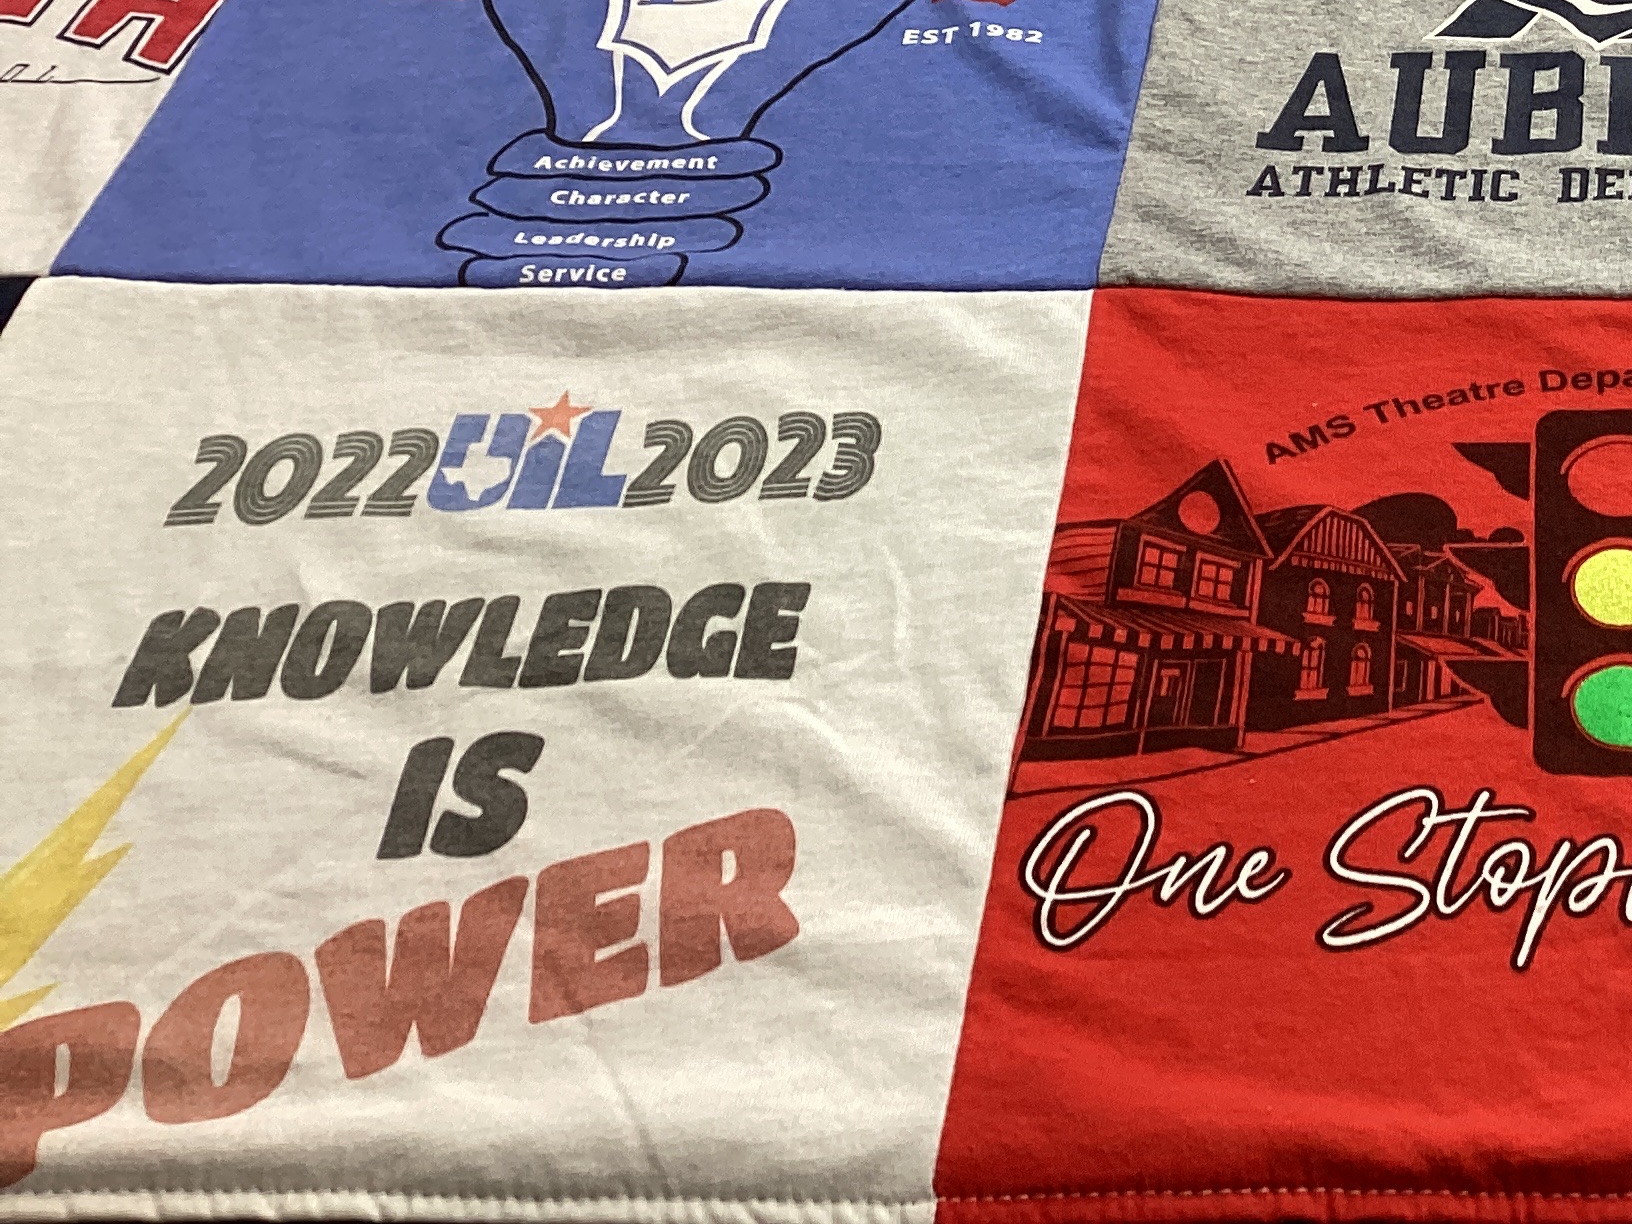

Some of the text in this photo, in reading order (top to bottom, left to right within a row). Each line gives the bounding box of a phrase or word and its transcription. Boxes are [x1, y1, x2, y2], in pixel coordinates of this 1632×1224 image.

[902, 21, 1044, 46] EST 1982
[533, 154, 719, 173] Achievement
[1246, 162, 1522, 204] ATHLETIC
[550, 189, 691, 207] Character
[513, 231, 676, 251] Leadership
[519, 263, 628, 286] Service
[1264, 414, 1359, 466] AMS
[1363, 375, 1526, 428] Theatre
[163, 426, 440, 528] 2022
[624, 410, 883, 509] 2023
[111, 581, 812, 708] KNOWLEDGE
[376, 730, 546, 860] IS
[1022, 788, 1291, 949] One
[0, 807, 802, 1188] POWER
